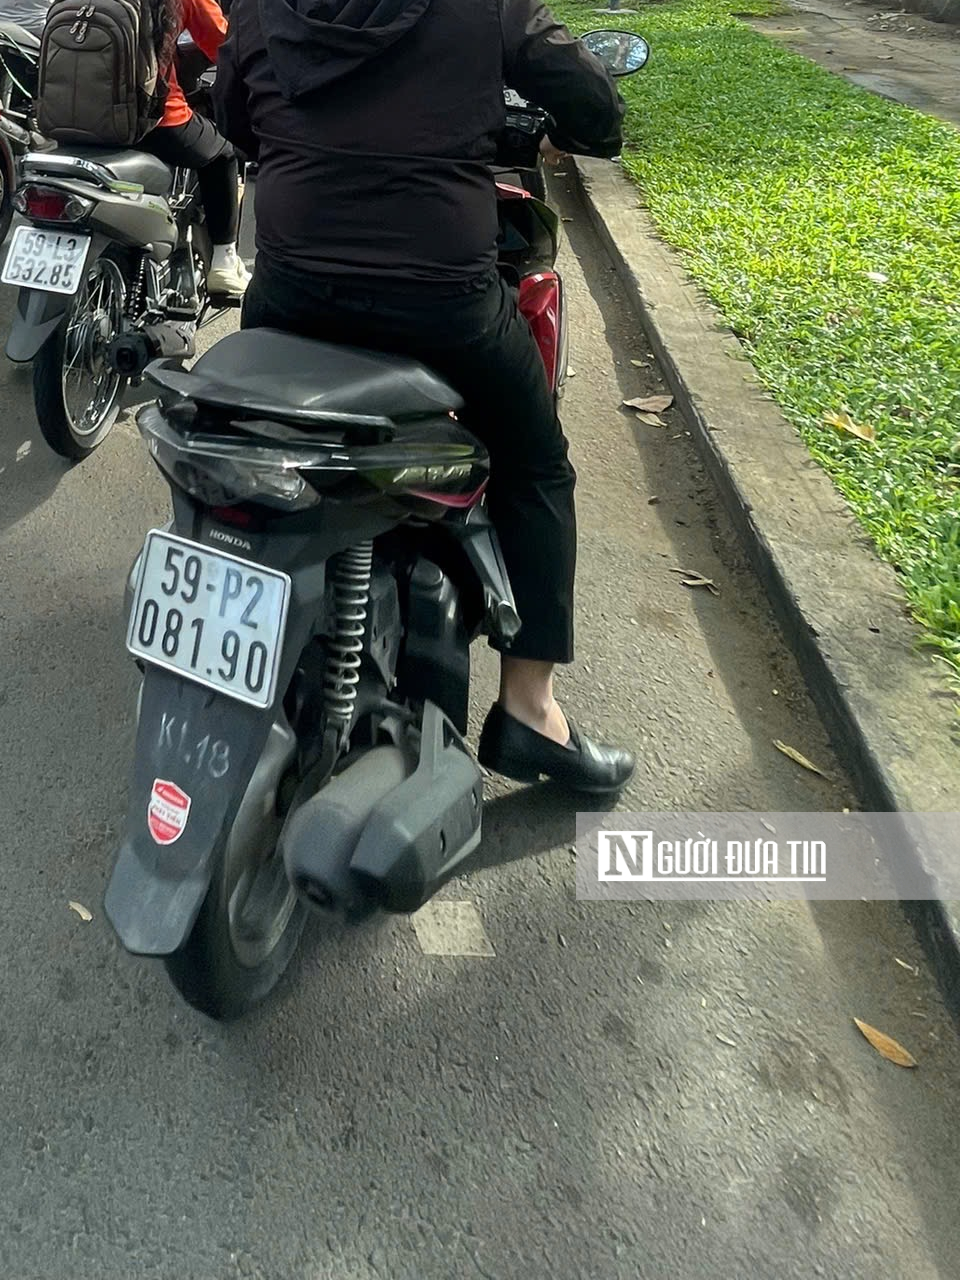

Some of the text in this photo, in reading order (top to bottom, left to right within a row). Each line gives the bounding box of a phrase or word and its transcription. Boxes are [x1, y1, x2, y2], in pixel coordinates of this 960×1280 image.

[22, 232, 78, 261] 59-L3
[10, 255, 75, 288] 532.85
[209, 528, 252, 550] HONDA
[161, 546, 264, 630] 59-P2
[138, 599, 268, 693] 081.90
